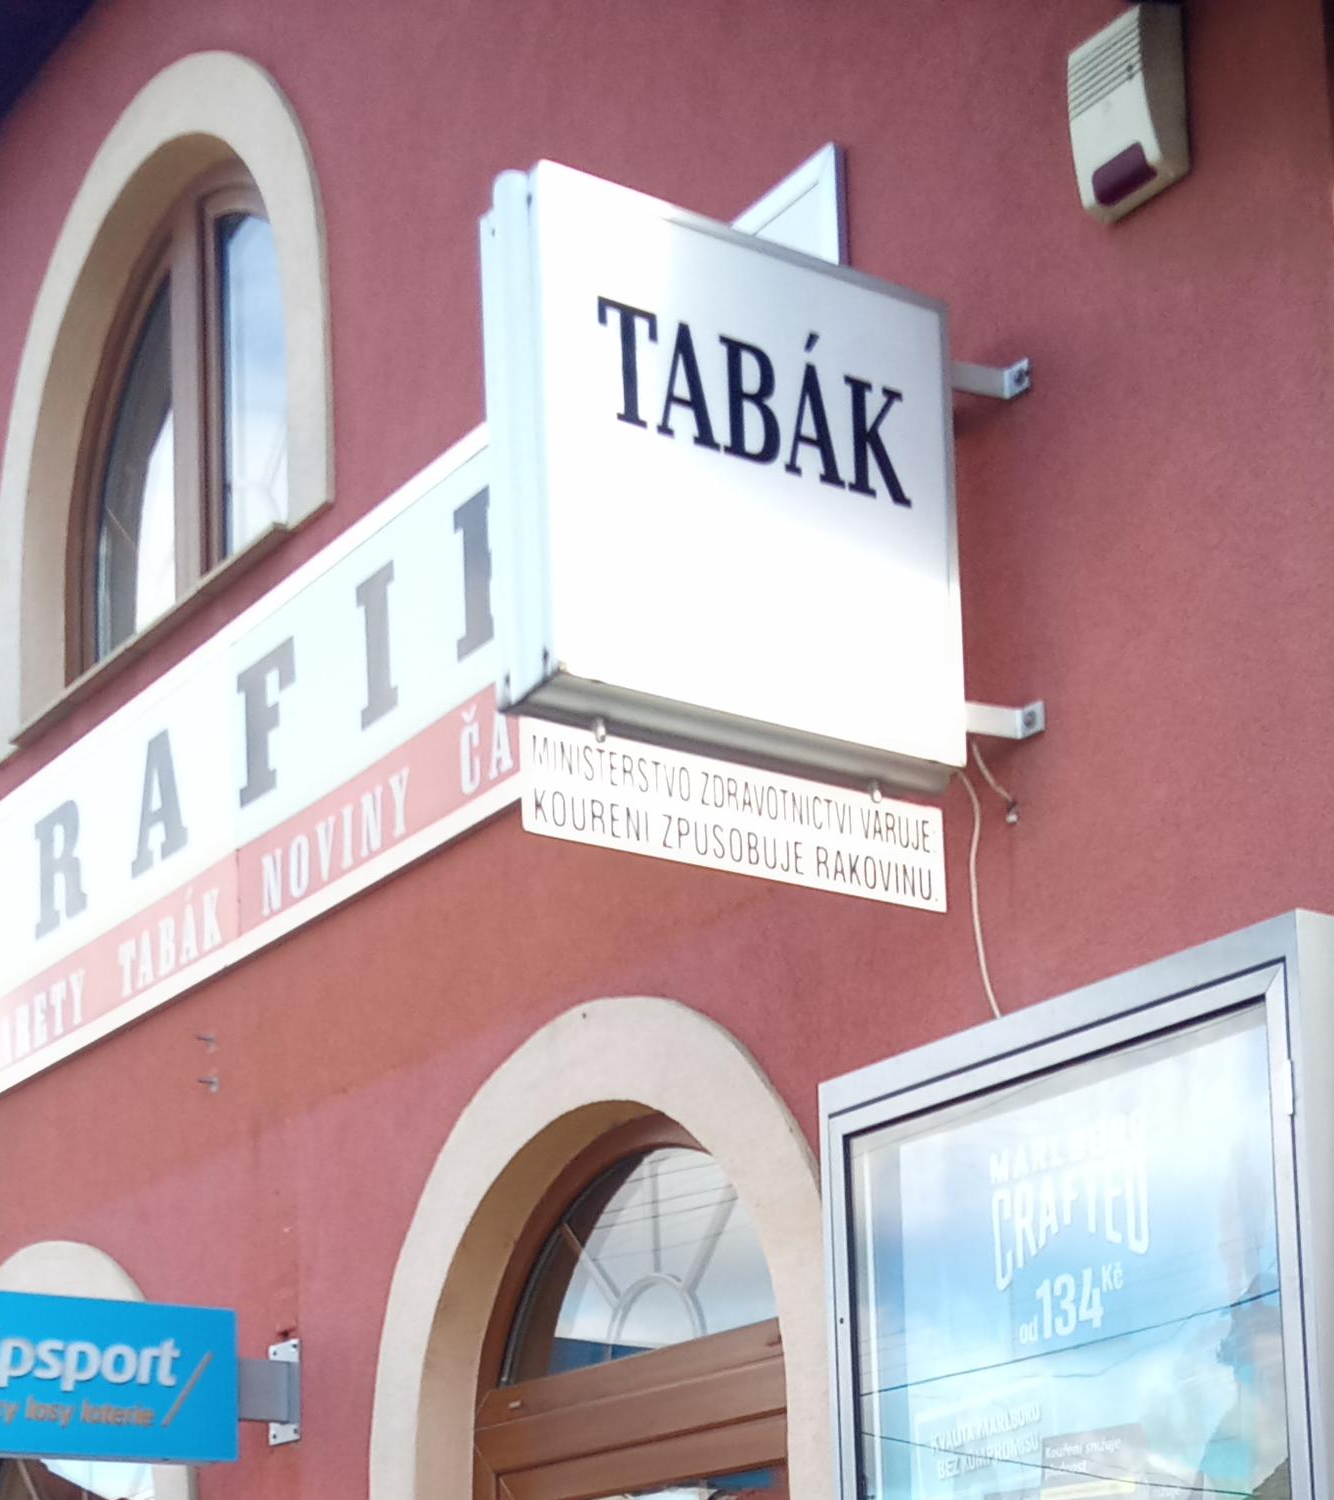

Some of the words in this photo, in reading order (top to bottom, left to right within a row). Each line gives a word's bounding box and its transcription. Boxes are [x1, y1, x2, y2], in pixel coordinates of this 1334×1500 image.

[597, 295, 912, 509] TABÁK
[531, 733, 692, 803] MINISTERSTVO
[700, 771, 855, 834] ZDRAVOTNICTVI
[117, 887, 223, 999] TABÁK
[260, 767, 411, 918] NOVINY
[458, 703, 517, 796] ČA
[533, 788, 650, 842] KOURENI
[661, 813, 804, 876] ZPUSOBUJE
[1035, 1266, 1104, 1340] 134
[1101, 1262, 1124, 1292] Kč
[25, 1396, 75, 1428] losy
[82, 1399, 156, 1428] loterie
